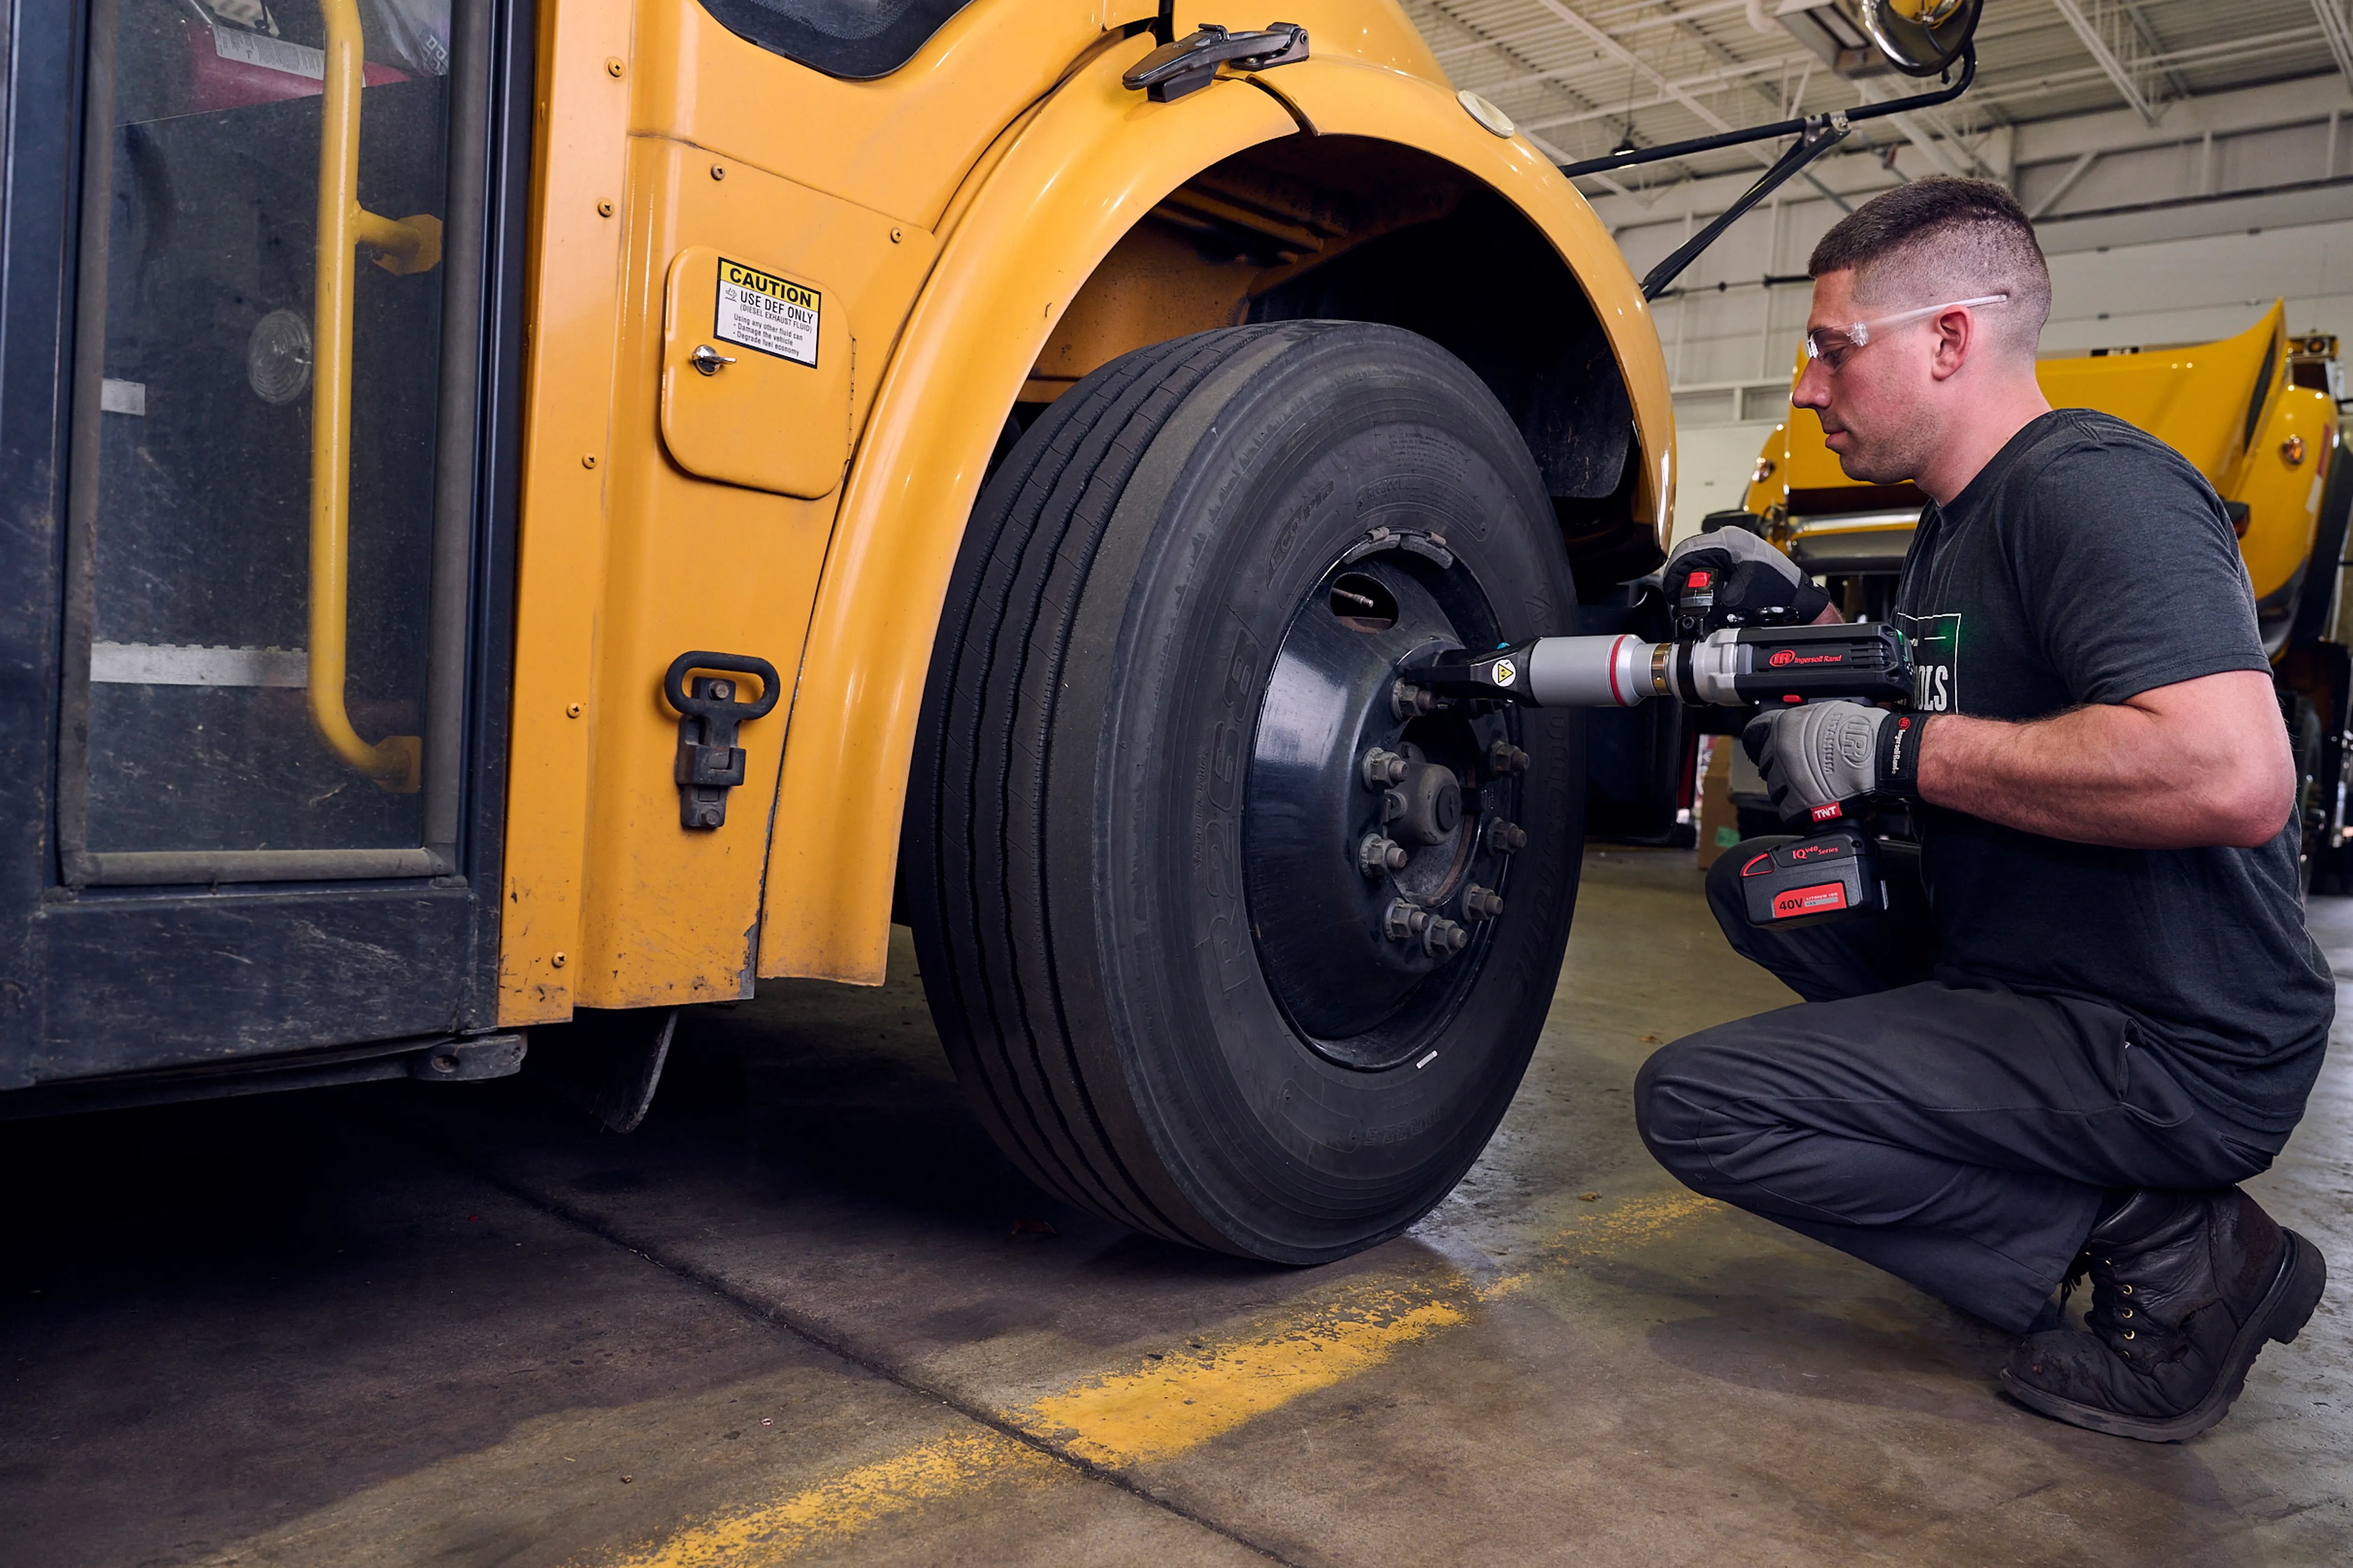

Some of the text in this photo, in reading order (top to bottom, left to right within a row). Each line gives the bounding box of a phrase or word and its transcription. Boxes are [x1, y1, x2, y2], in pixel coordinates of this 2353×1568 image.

[730, 268, 811, 308] CAUTION
[740, 304, 812, 334] (DIESEL EXHAUST FLUID)
[741, 290, 813, 324] USE DEF ONLY
[734, 313, 803, 341] Using any other fluid can
[738, 323, 793, 346] Damage the vehicle
[737, 331, 799, 357] Degrade fuel economy
[1772, 652, 1842, 665] IR Ingersoll Rand
[1913, 664, 1949, 712] OLS
[1842, 721, 1871, 759] IR
[1814, 806, 1836, 818] TNT
[1818, 847, 1839, 855] Series
[1779, 898, 1803, 911] 40V
